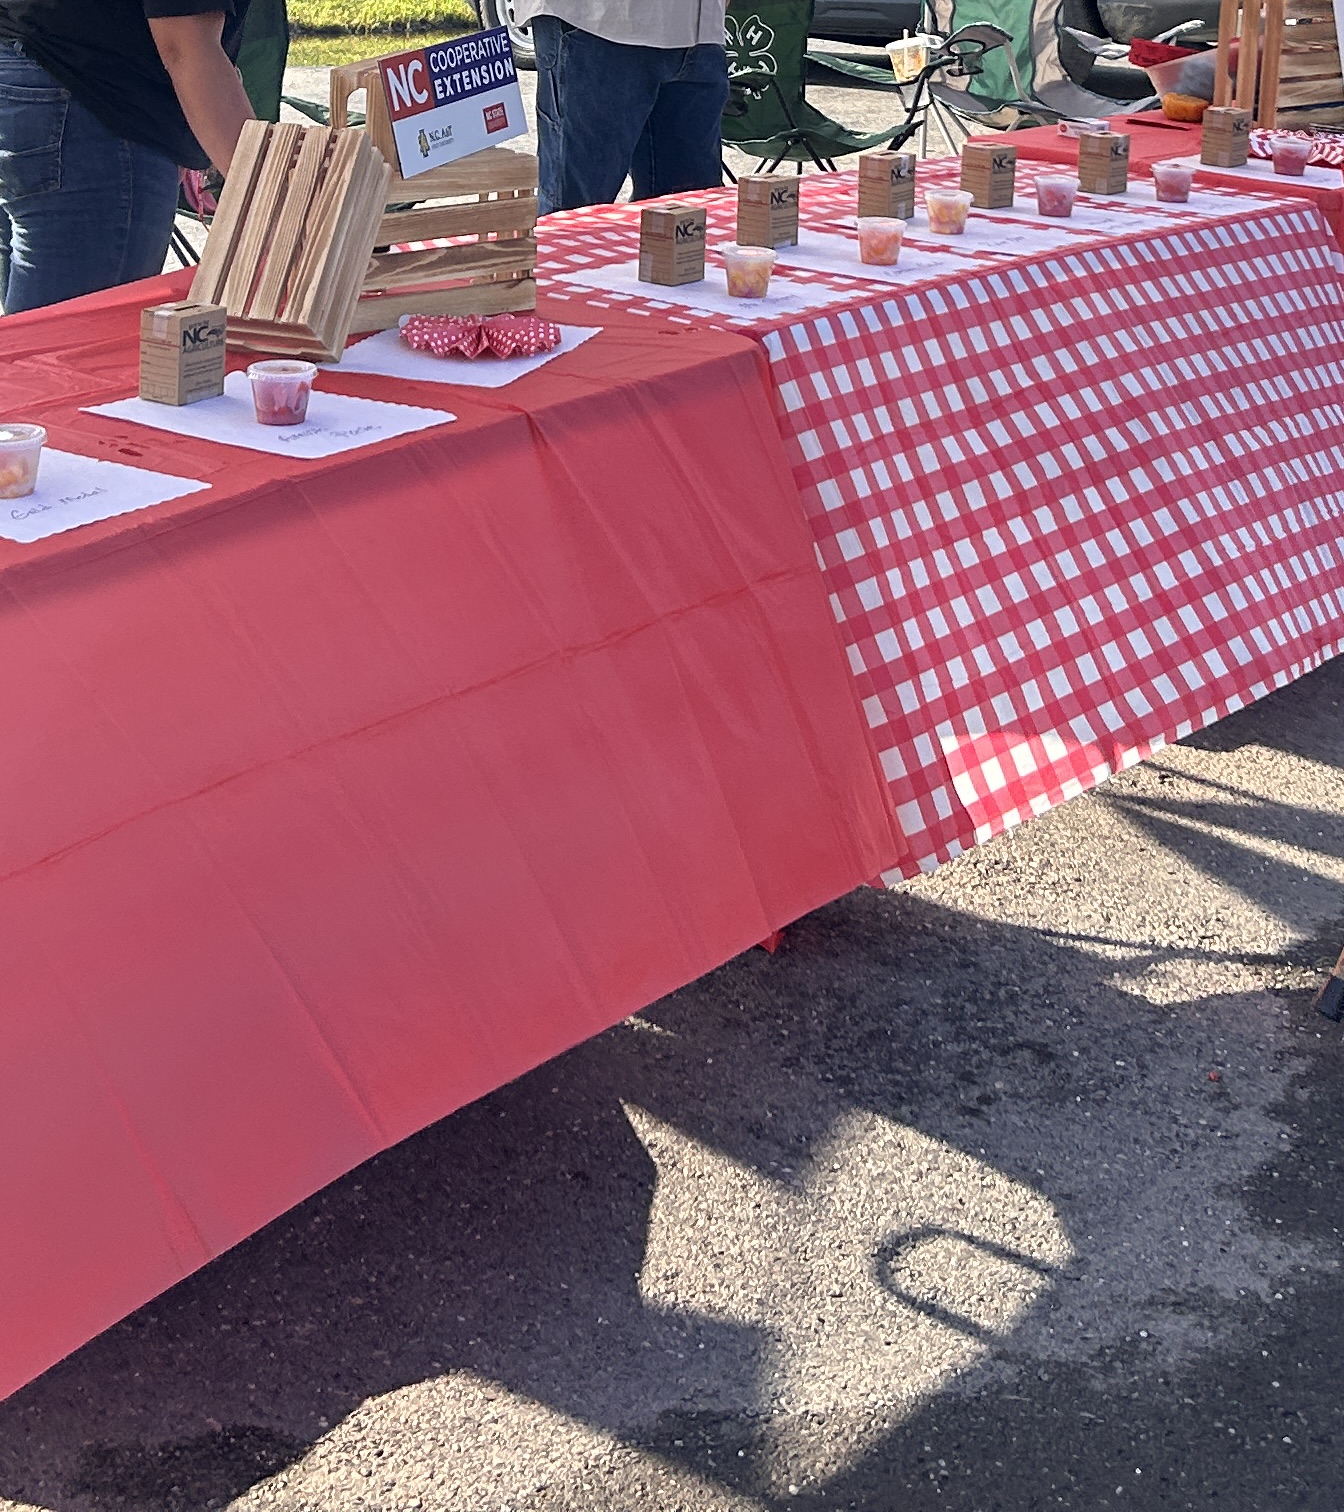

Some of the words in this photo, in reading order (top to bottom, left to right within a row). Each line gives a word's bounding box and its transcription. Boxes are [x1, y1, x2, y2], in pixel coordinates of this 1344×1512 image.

[429, 32, 510, 73] COOPERATIVE
[387, 59, 429, 111] NC
[434, 57, 515, 99] EXTENSION
[770, 190, 789, 205] NC
[676, 222, 694, 239] NC
[183, 326, 208, 346] NC
